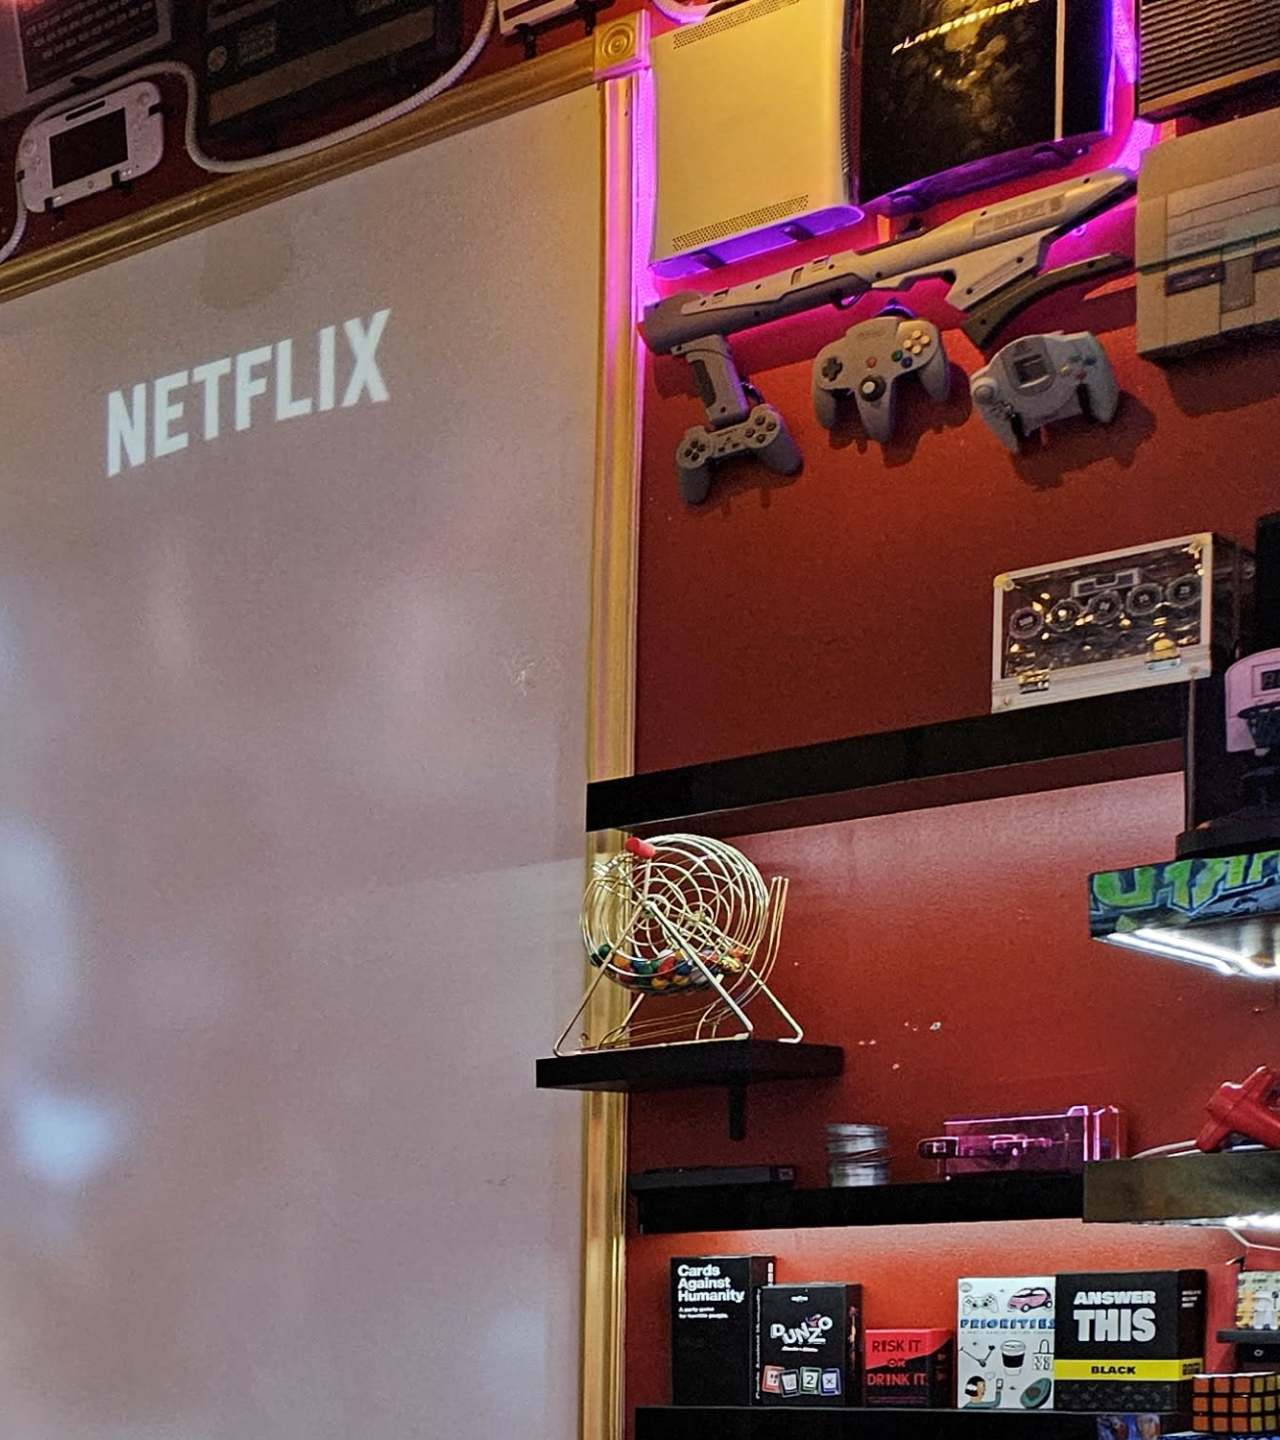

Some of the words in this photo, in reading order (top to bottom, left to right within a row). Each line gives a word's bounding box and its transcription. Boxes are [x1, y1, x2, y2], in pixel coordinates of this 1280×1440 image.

[107, 308, 392, 478] NETFLIX
[677, 1264, 721, 1277] Cards
[677, 1277, 732, 1291] Against
[677, 1289, 745, 1303] Humanity
[1073, 1290, 1157, 1305] ANSWER
[959, 1318, 1056, 1330] PRIORITIES
[1073, 1308, 1156, 1342] THIS
[872, 1340, 905, 1352] RISK
[908, 1340, 922, 1352] IT
[1091, 1365, 1136, 1375] BLACK
[867, 1373, 910, 1386] DRINK
